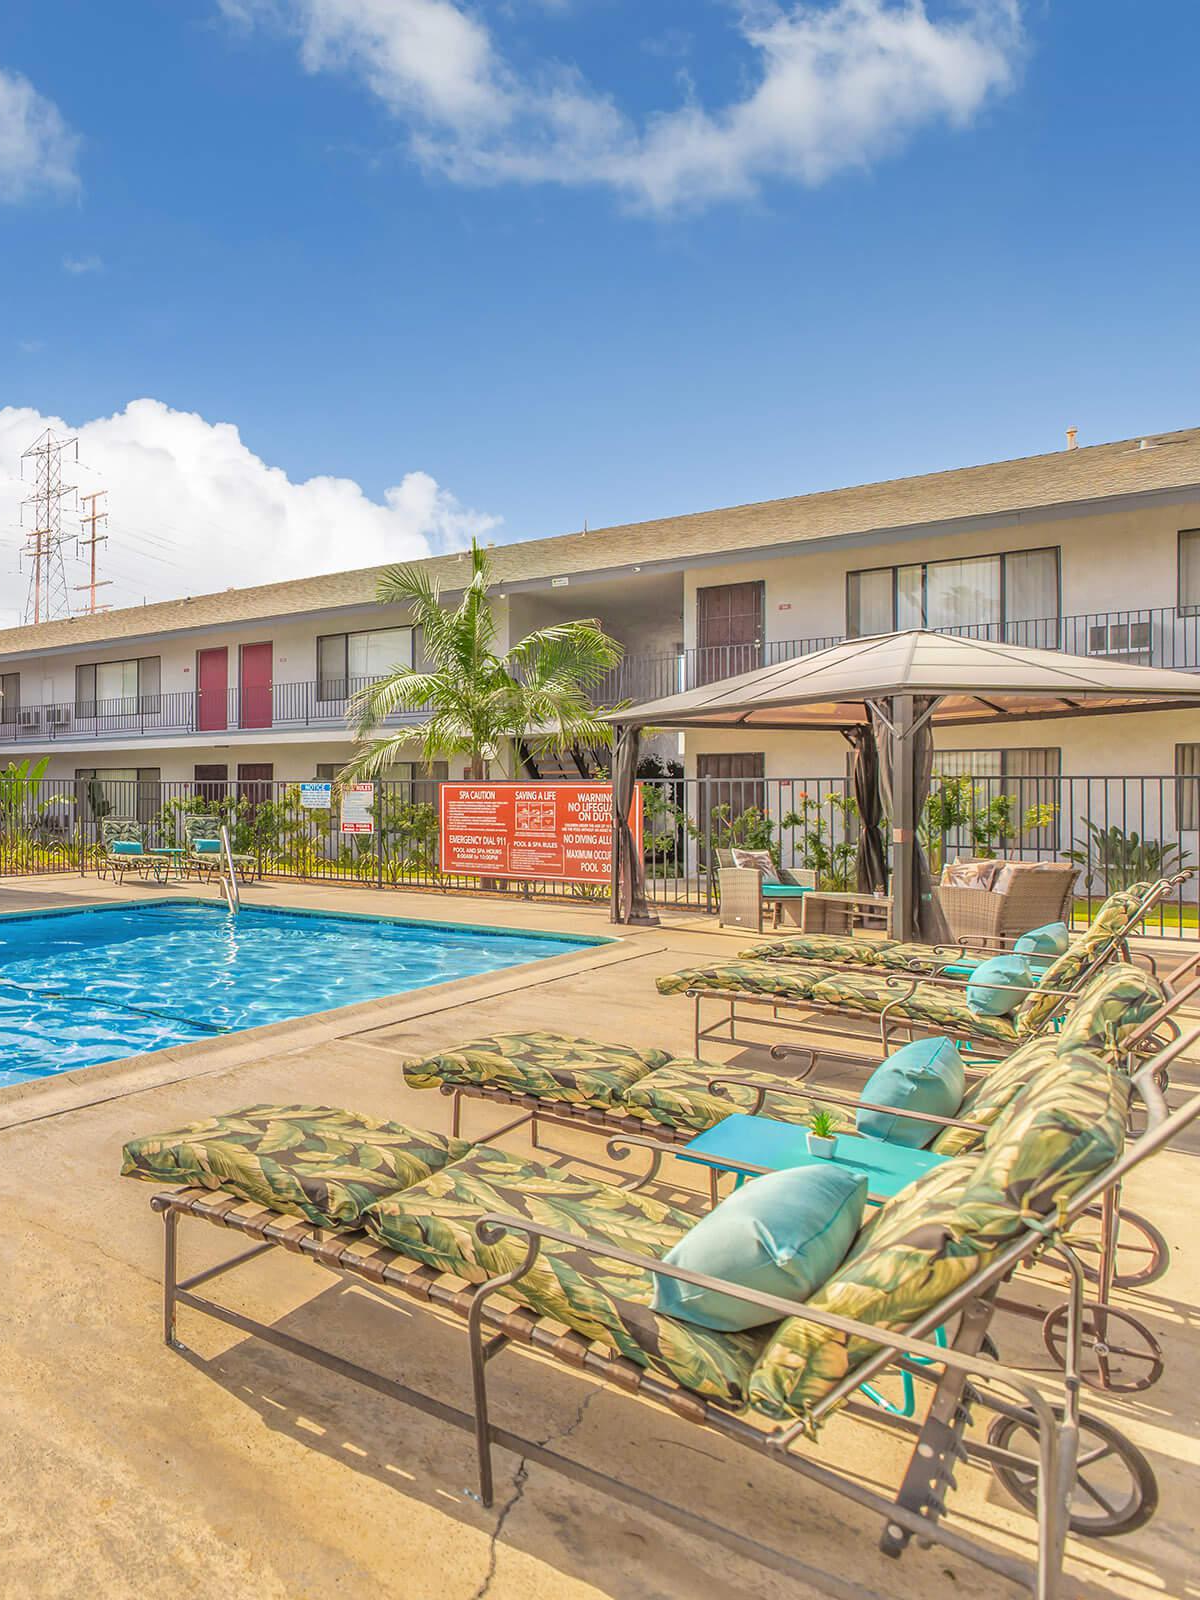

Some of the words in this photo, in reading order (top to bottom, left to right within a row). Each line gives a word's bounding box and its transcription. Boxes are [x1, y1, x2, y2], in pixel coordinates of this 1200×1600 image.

[459, 790, 470, 800] SPA
[470, 790, 496, 800] CAUTION
[515, 791, 537, 801] SAVING
[538, 791, 543, 801] A
[543, 791, 556, 801] LIFE
[567, 802, 581, 812] NO
[582, 802, 613, 812] LIFEGUA
[578, 811, 591, 821] ON
[449, 834, 482, 845] EMERGENCY
[483, 835, 496, 846] DIAL
[496, 836, 506, 847] 911
[563, 834, 574, 844] NO
[575, 834, 597, 845] DIVING
[452, 846, 465, 854] POOL
[566, 849, 593, 860] MAXIMUM
[593, 850, 612, 860] OCCUP
[580, 862, 599, 873] POOL
[601, 863, 612, 873] 30
